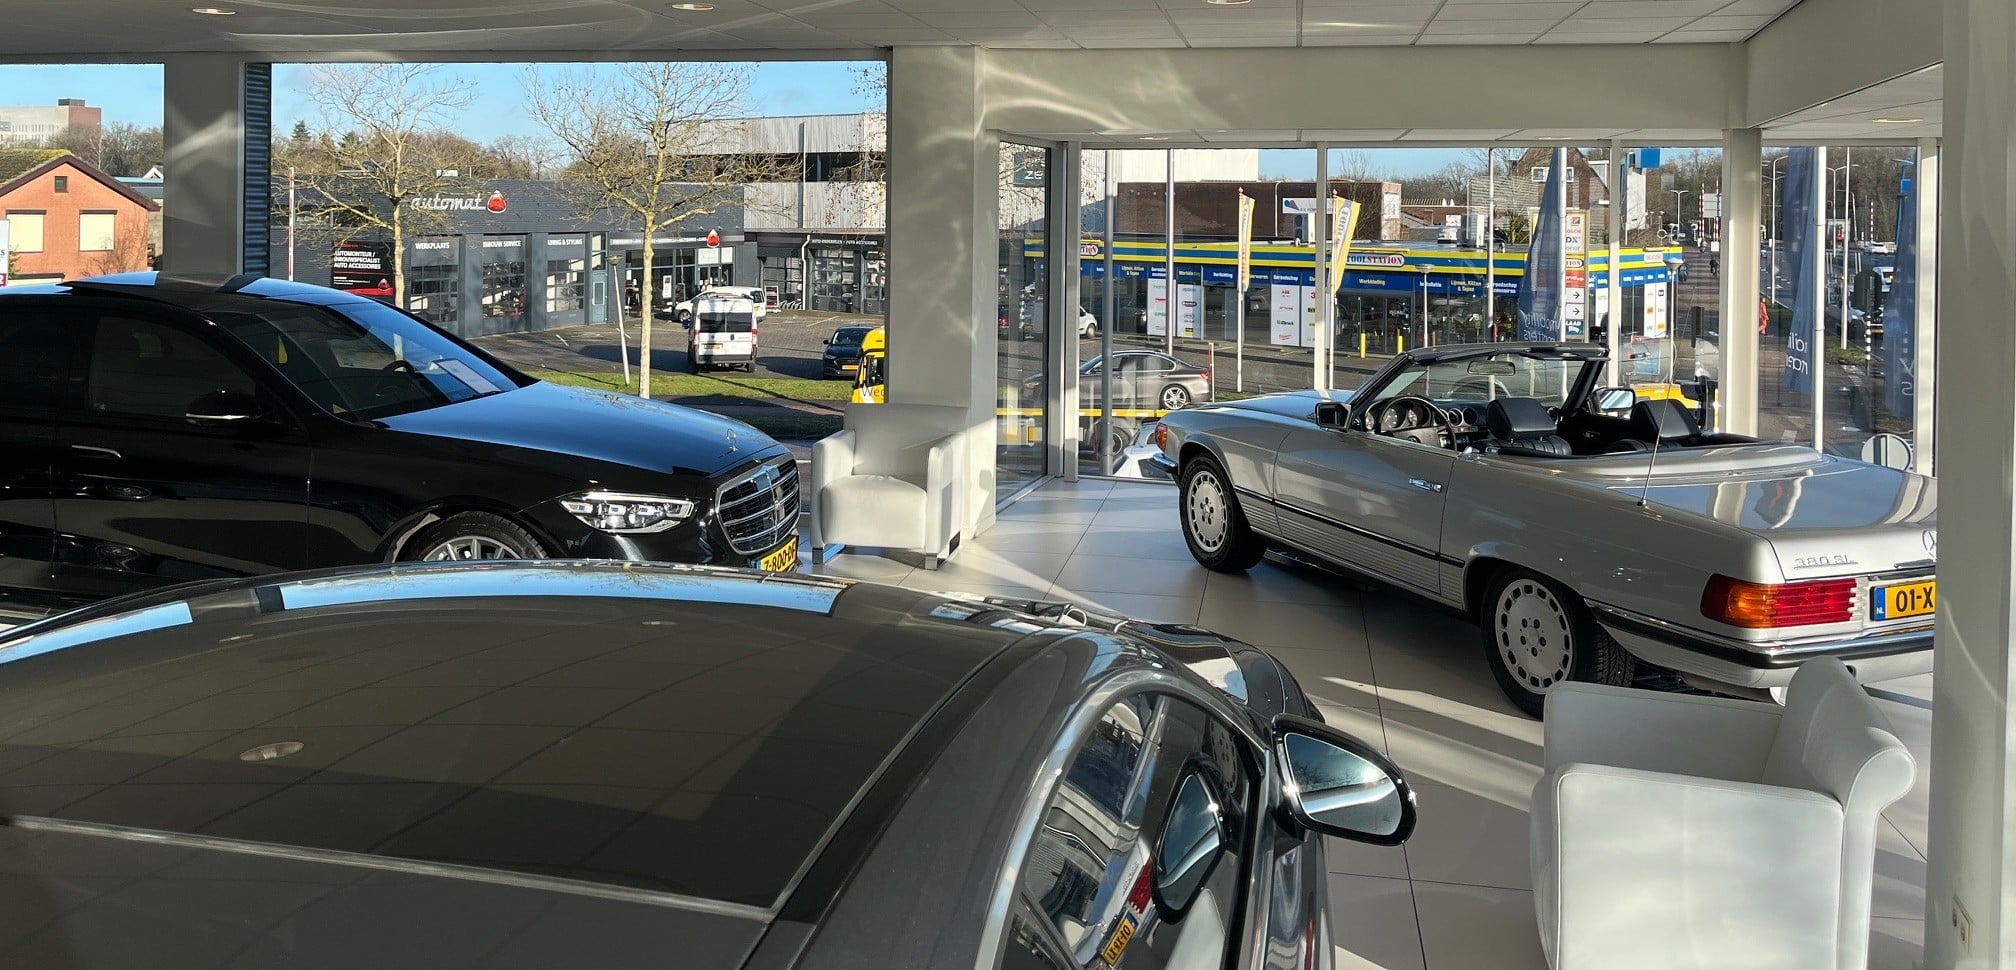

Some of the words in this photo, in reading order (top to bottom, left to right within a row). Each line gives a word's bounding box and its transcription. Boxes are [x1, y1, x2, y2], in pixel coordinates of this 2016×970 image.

[411, 193, 486, 210] automat
[1347, 255, 1403, 264] TOOLSTATION
[1795, 556, 1830, 567] 380
[1834, 554, 1856, 564] SL
